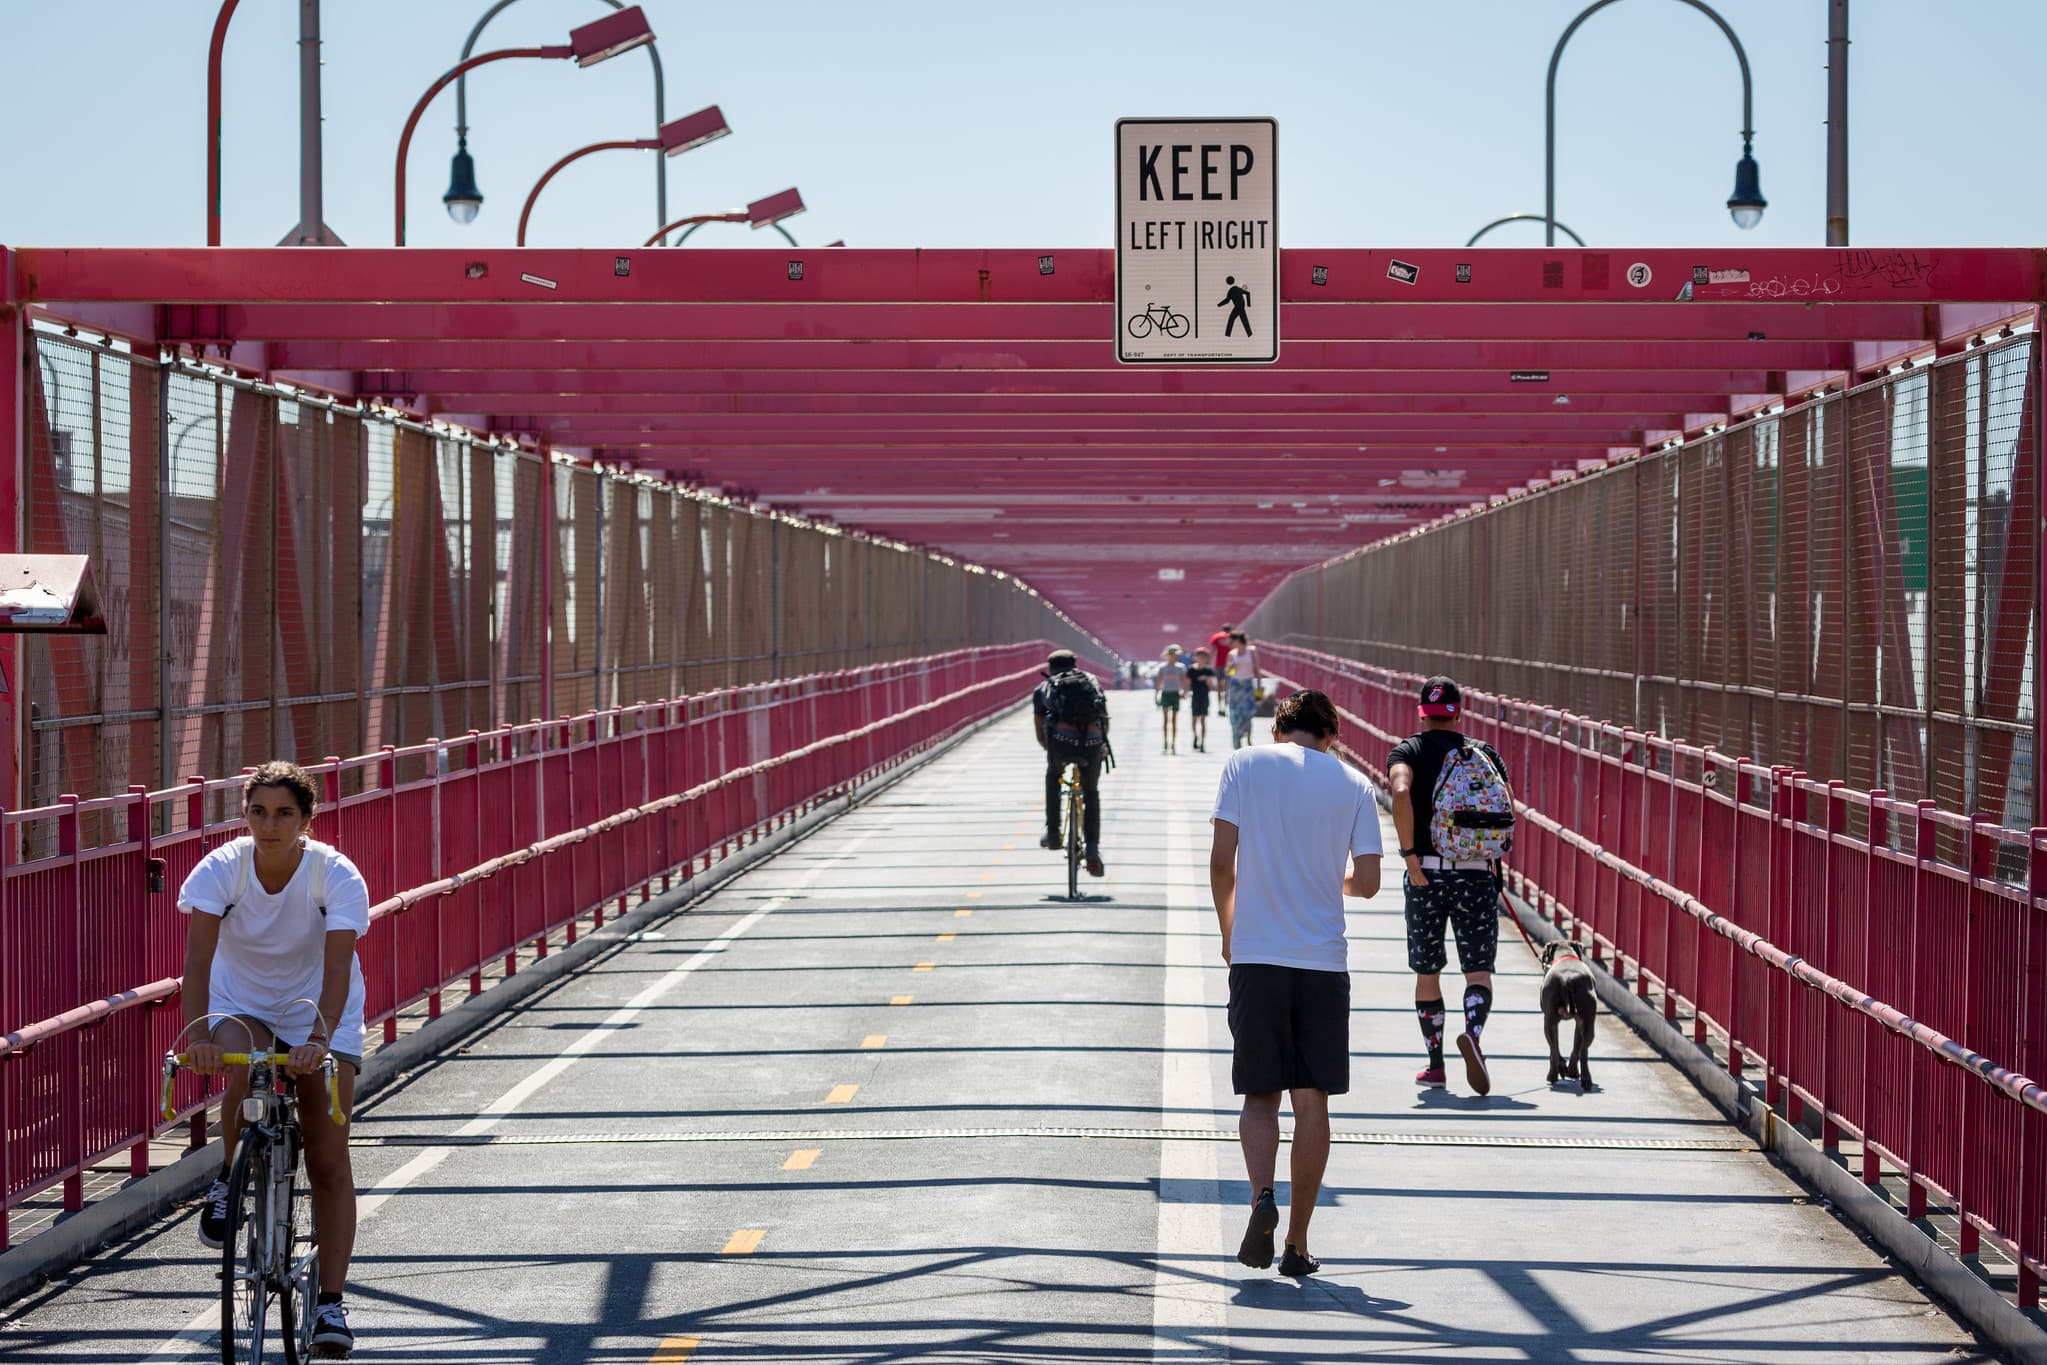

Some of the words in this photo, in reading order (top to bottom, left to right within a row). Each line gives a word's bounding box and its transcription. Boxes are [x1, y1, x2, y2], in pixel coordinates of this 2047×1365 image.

[1139, 144, 1254, 201] KEEP
[1131, 221, 1186, 250] LEFT
[1202, 220, 1268, 249] RIGHT
